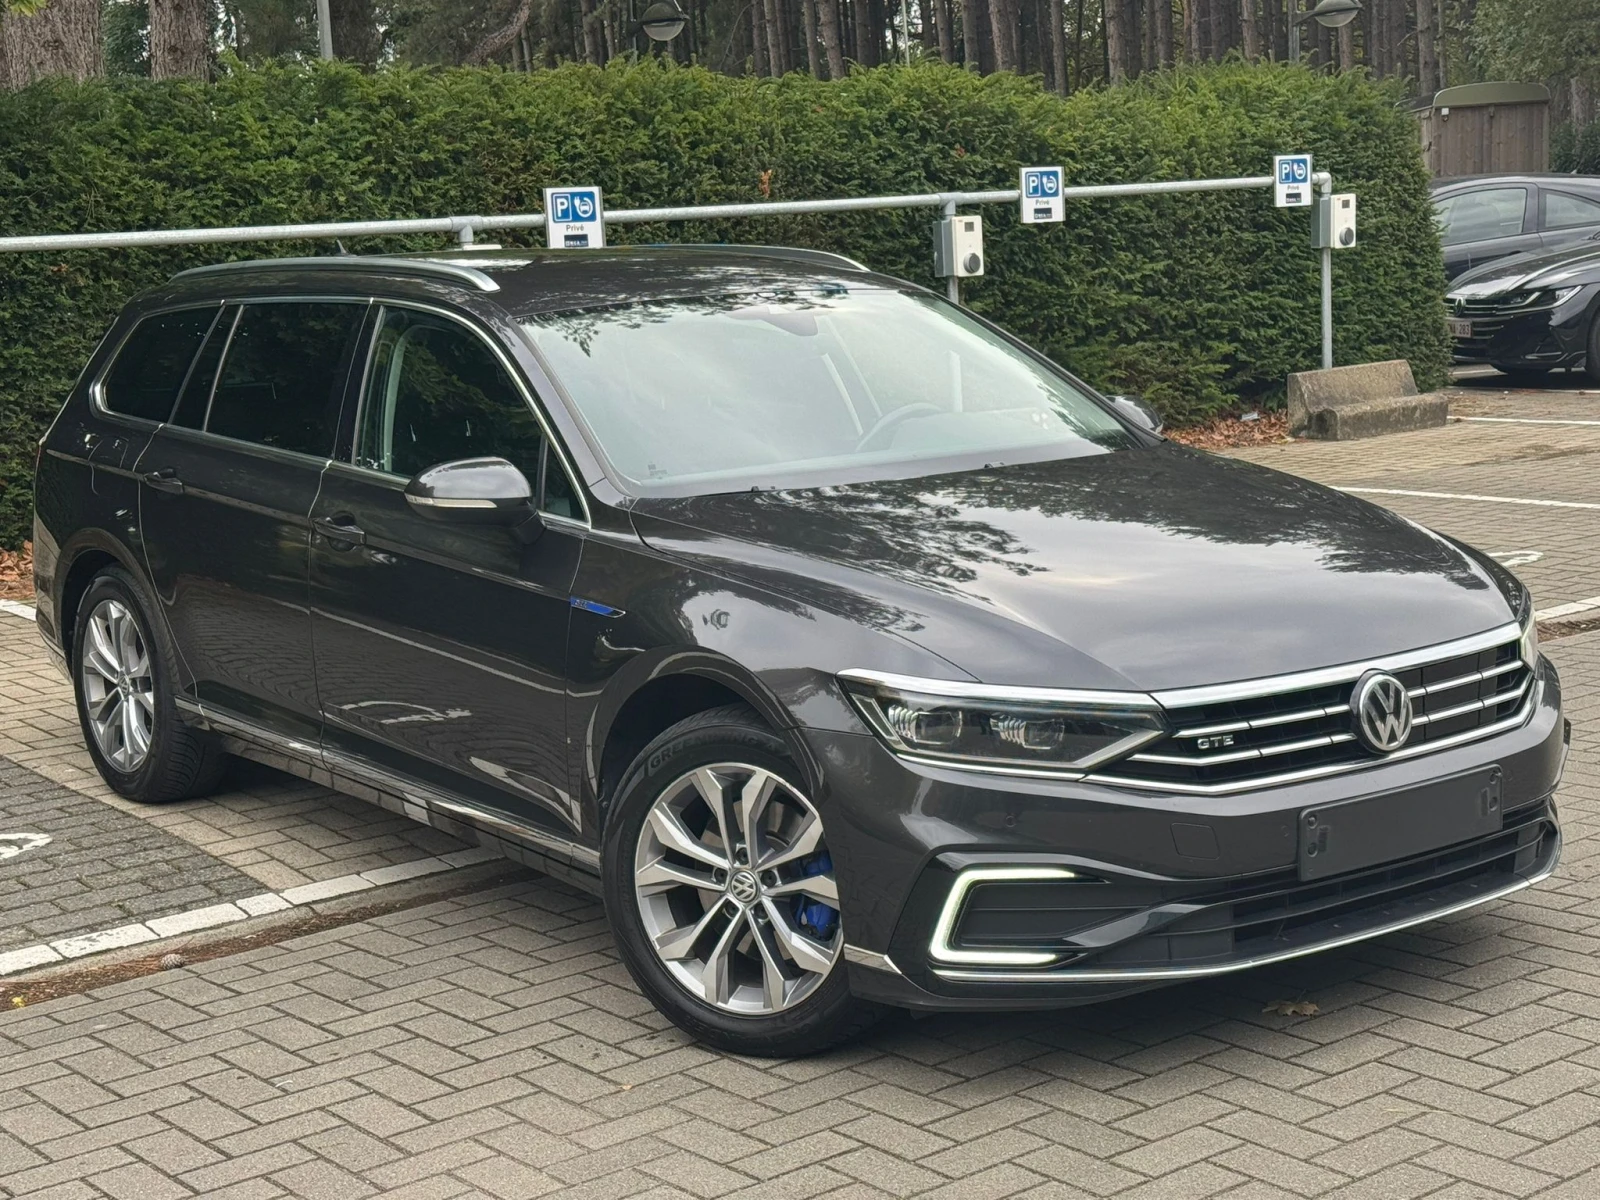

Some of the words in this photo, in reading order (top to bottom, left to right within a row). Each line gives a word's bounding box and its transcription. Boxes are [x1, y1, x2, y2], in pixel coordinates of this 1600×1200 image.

[1281, 163, 1290, 180] P
[1029, 176, 1038, 194] P
[556, 197, 569, 218] P
[566, 223, 585, 232] Privé
[1197, 734, 1235, 750] GTE
